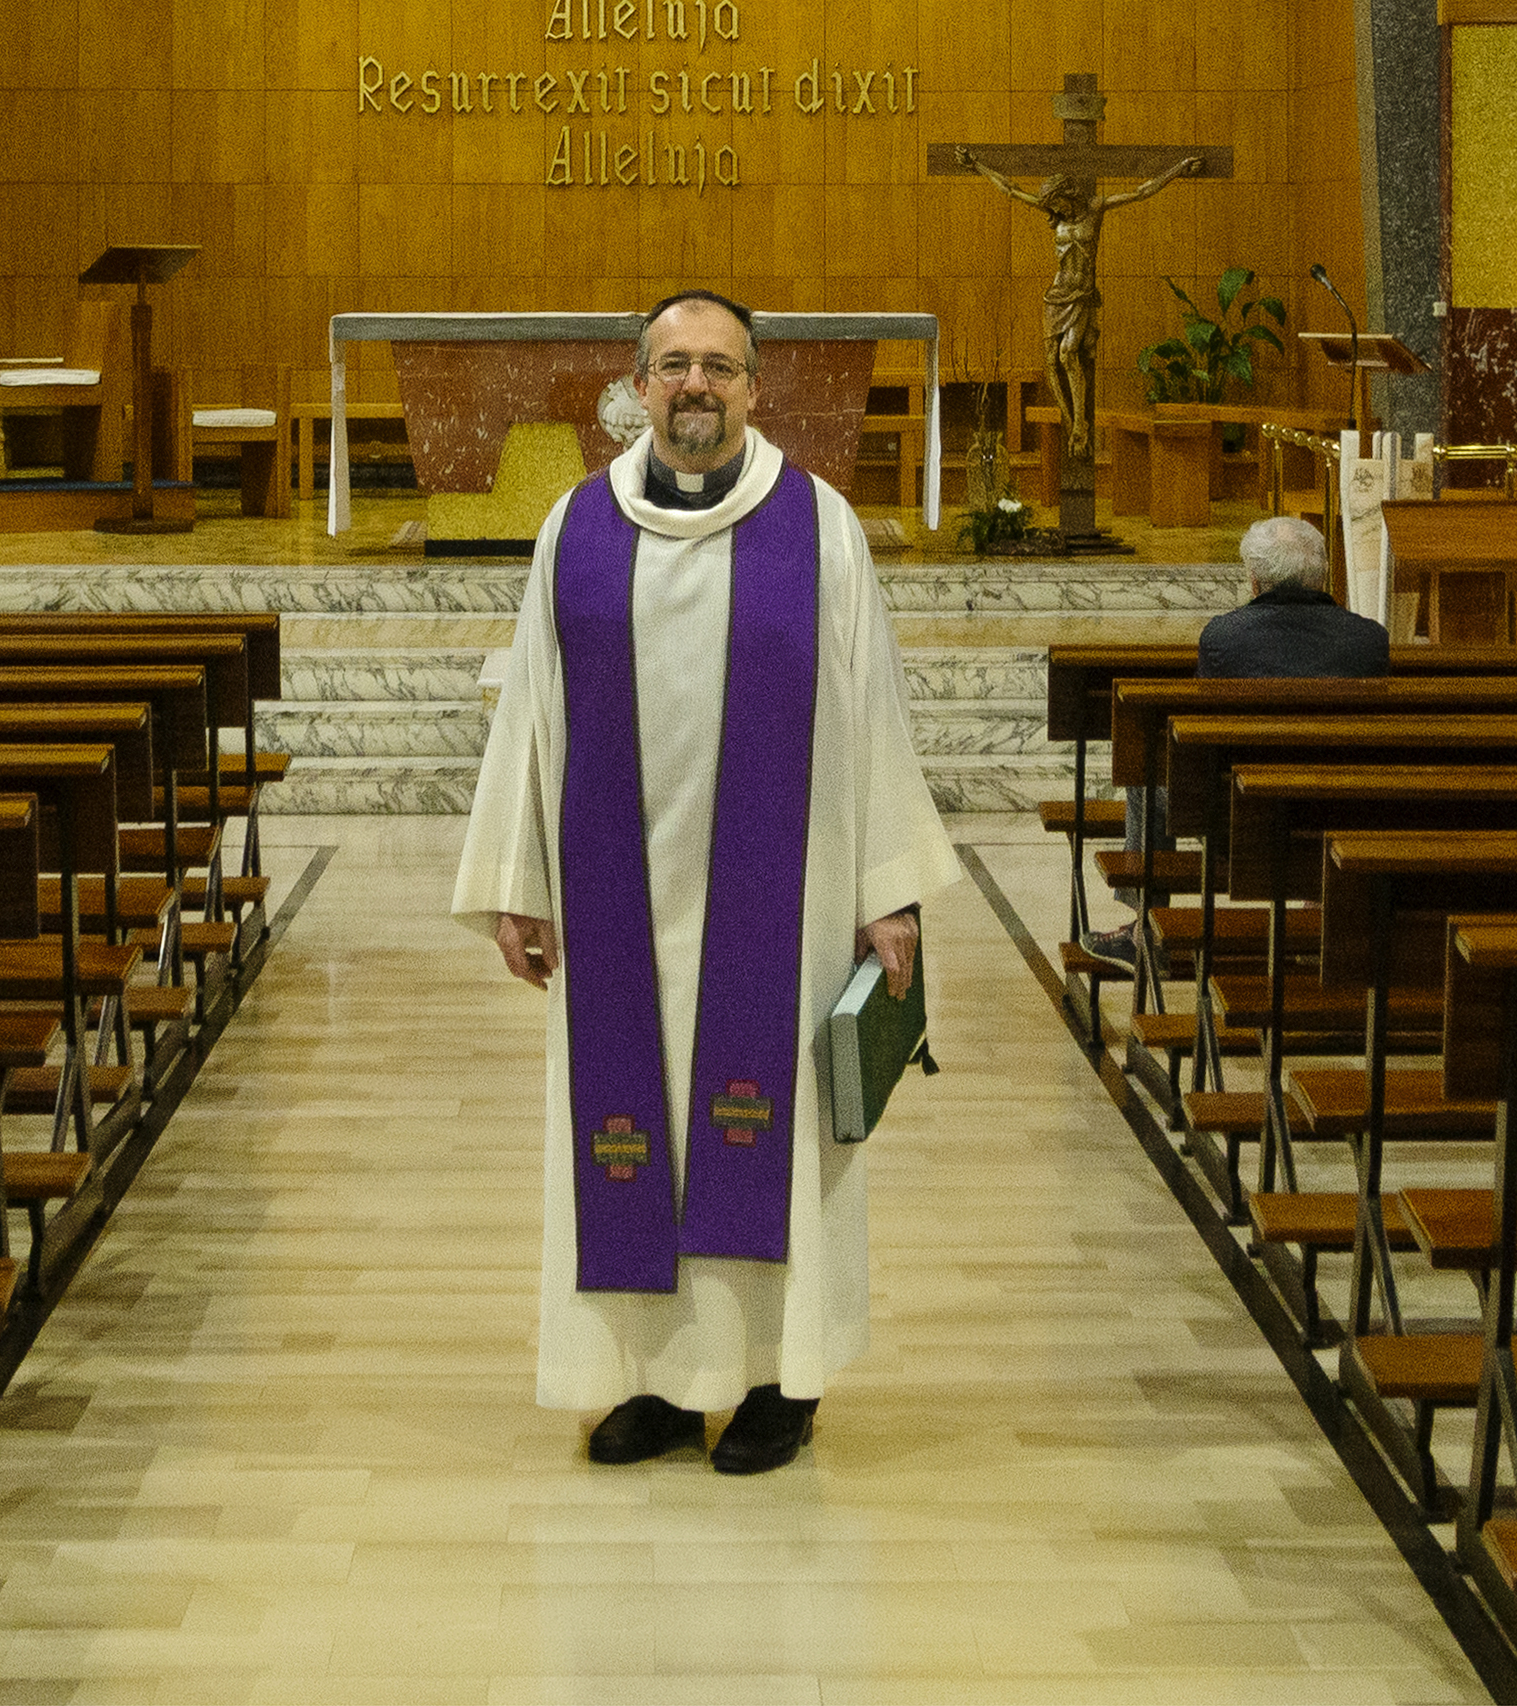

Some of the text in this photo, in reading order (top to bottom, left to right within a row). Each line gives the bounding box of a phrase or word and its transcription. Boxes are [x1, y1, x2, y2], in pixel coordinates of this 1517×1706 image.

[358, 55, 919, 114] Resurrexit sicut dixit
[545, 125, 742, 197] Alleluja
